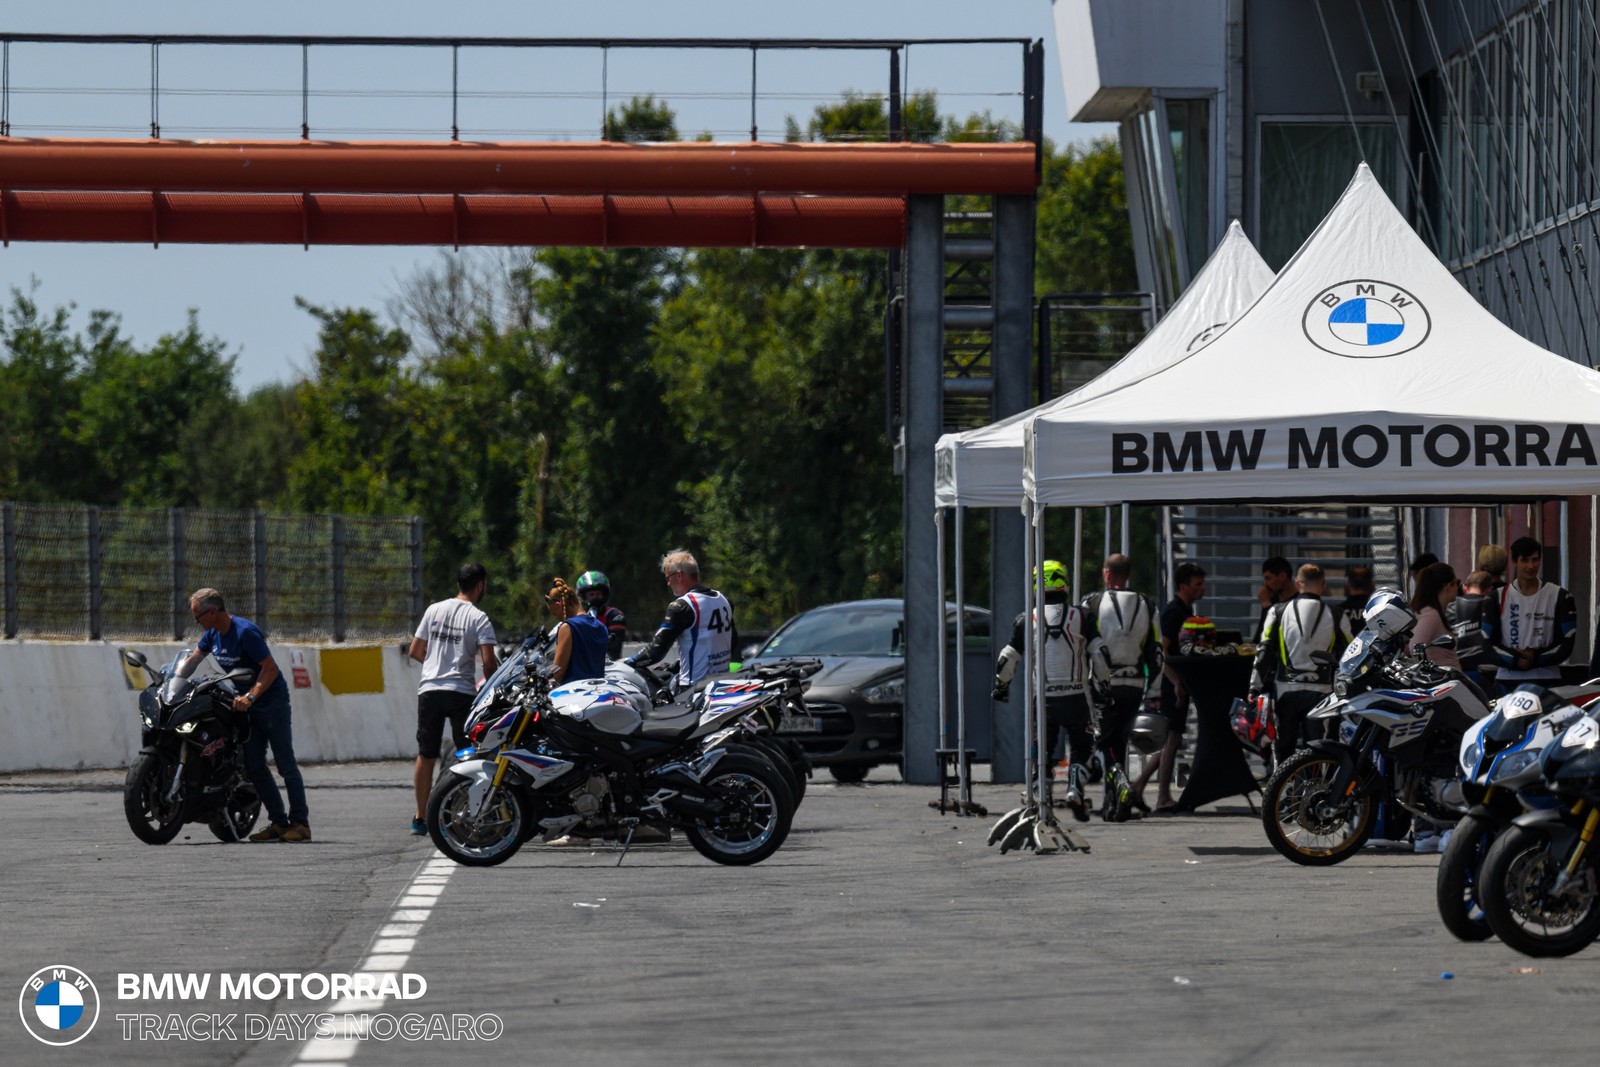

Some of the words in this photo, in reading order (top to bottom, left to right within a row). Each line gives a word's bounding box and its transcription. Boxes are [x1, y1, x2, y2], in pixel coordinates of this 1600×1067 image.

[1319, 282, 1415, 309] BMW
[1112, 427, 1266, 474] BMW
[1287, 422, 1599, 470] MOTORRA
[707, 606, 732, 635] 43
[1509, 696, 1534, 711] 180
